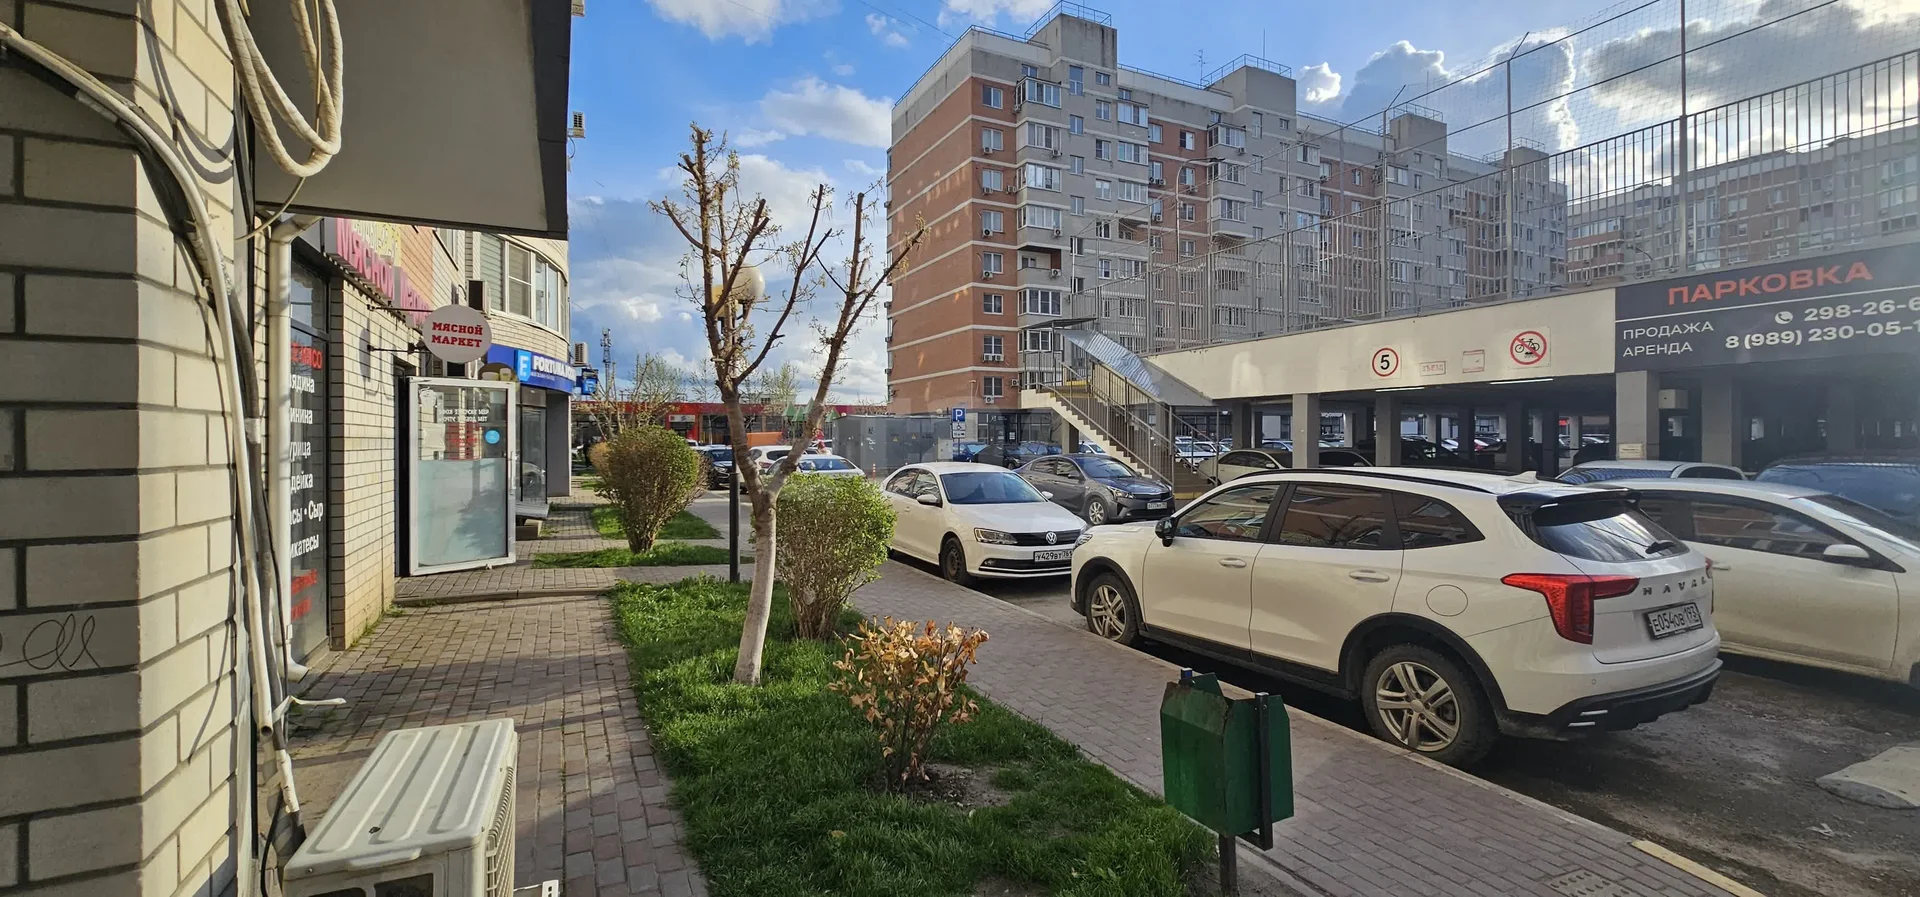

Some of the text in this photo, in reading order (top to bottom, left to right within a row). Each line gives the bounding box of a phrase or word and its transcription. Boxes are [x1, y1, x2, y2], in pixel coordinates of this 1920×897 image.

[1668, 262, 1873, 306] ПАРКОВКА
[1804, 297, 1920, 322] 298-26-6
[432, 322, 483, 335] МЯСНОЙ
[1623, 321, 1714, 340] ПРОДАЖА
[432, 335, 482, 347] МАРКЕТ
[1725, 335, 1740, 349] 8
[1744, 329, 1802, 349] (989)
[1623, 341, 1693, 357] АРЕНДА
[1380, 354, 1390, 370] 5
[955, 409, 963, 421] P
[291, 470, 313, 494] дейка
[308, 500, 324, 521] Сыр
[1643, 577, 1706, 595] HAVAL
